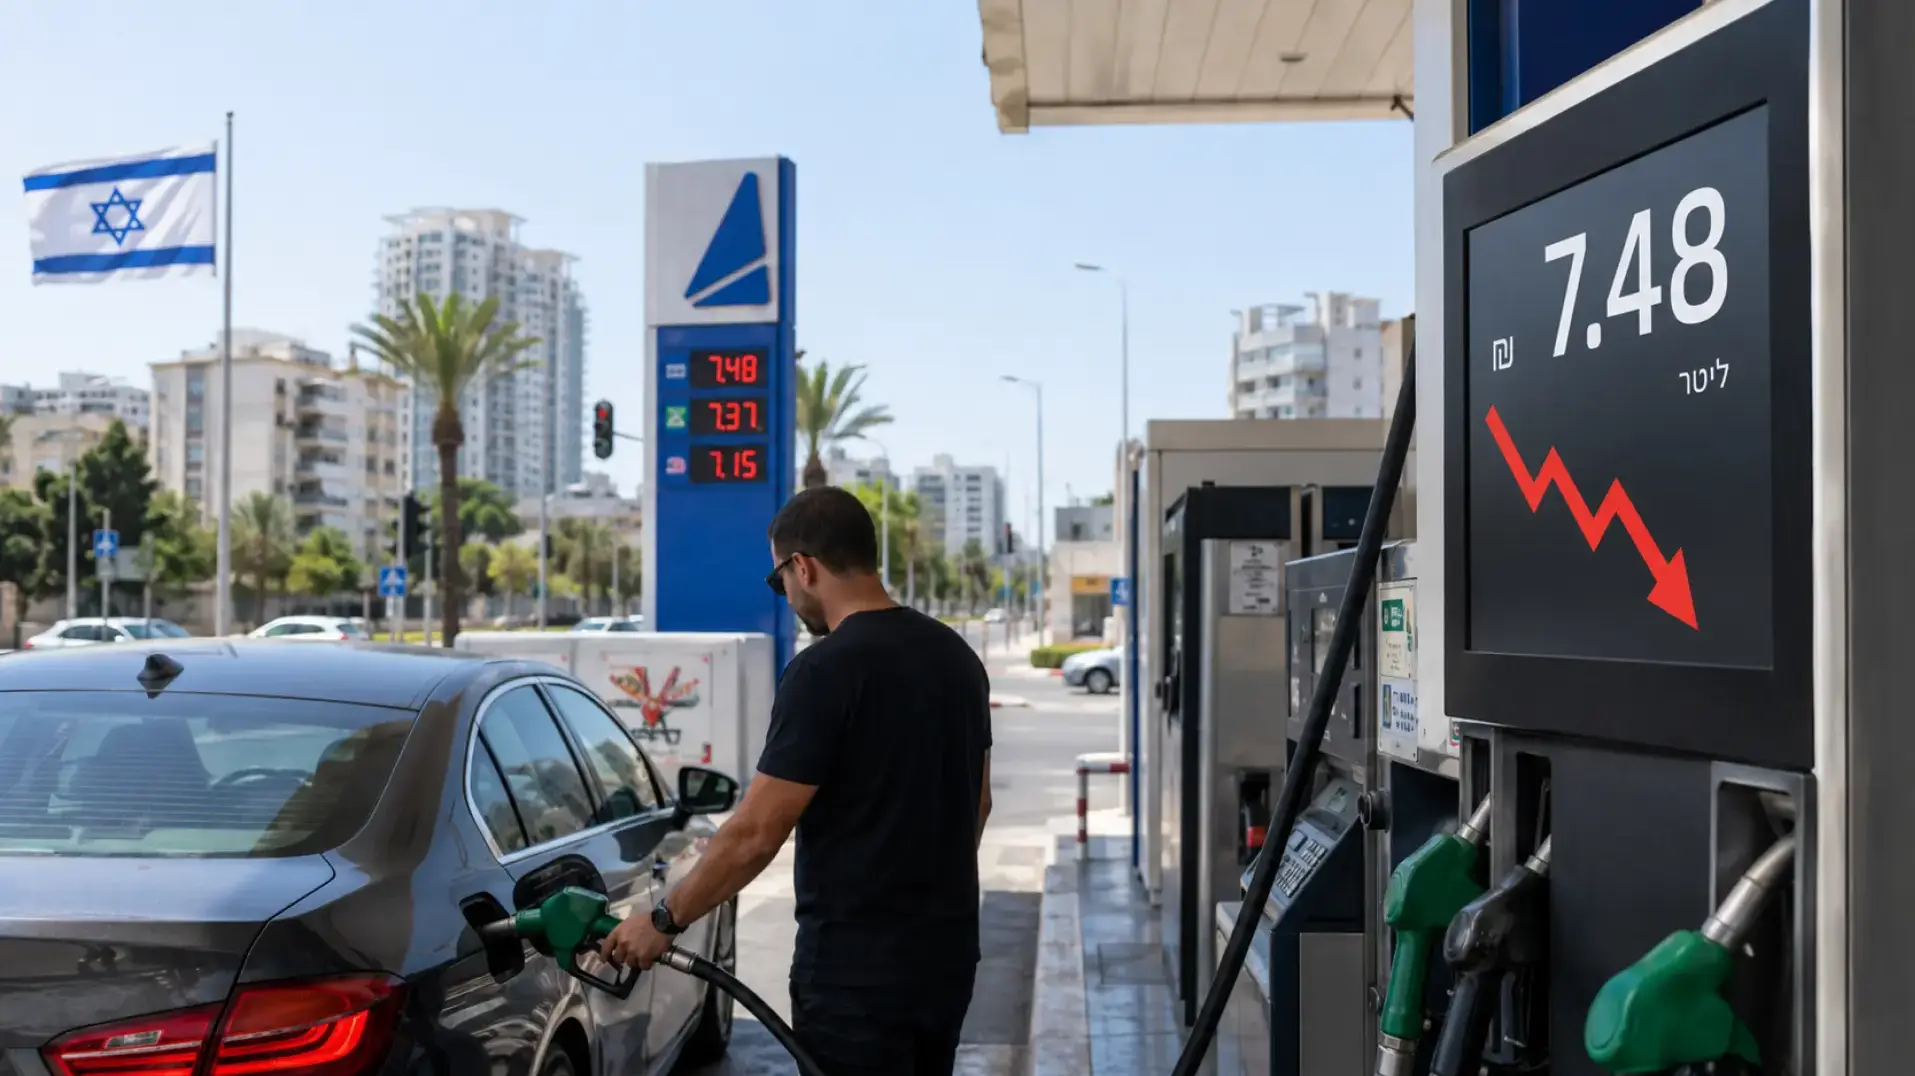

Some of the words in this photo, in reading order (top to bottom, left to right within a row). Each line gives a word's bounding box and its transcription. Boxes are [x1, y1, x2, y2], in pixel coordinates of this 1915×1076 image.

[1544, 186, 1728, 358] 7.48
[708, 354, 758, 384] 7.48
[1492, 335, 1514, 372] ₪
[1678, 357, 1730, 395] ליטר
[708, 401, 758, 431] 7.37
[709, 449, 757, 479] 7.15
